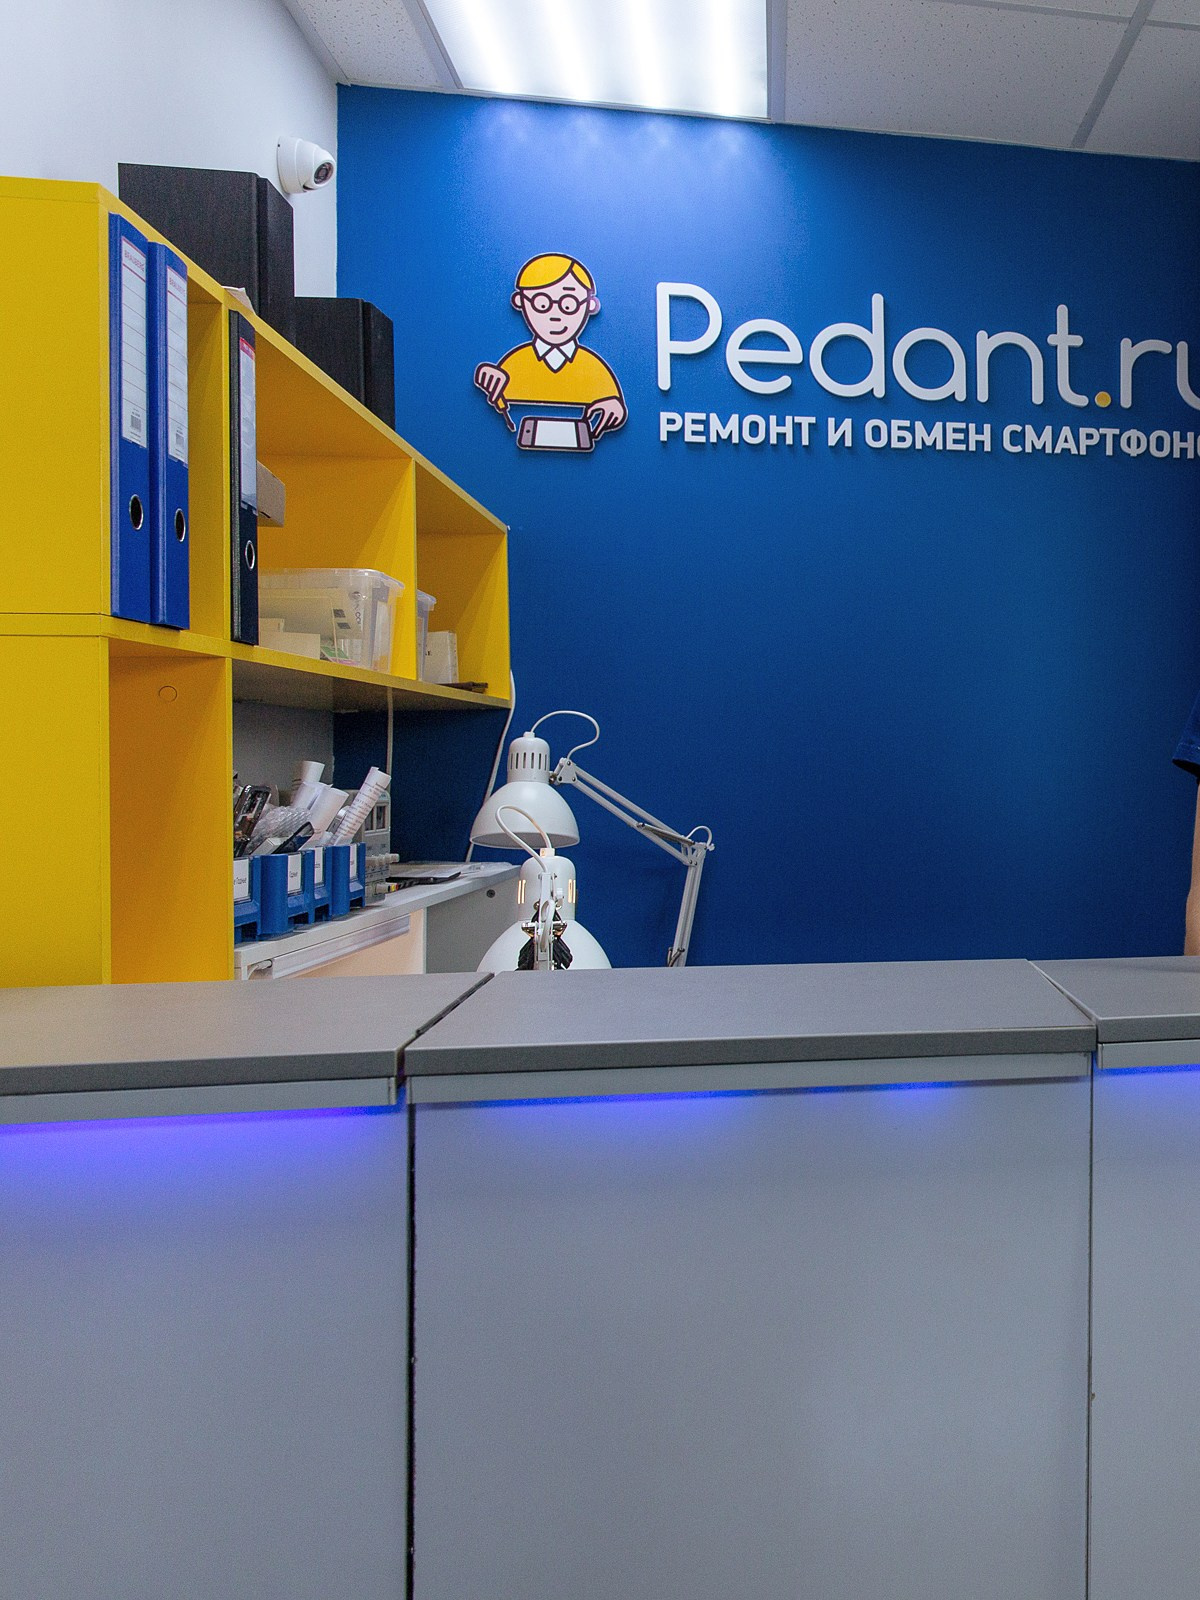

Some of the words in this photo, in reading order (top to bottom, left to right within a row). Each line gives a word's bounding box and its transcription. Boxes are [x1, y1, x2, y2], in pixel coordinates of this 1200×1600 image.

[659, 411, 816, 446] РЕМОНТ
[827, 417, 852, 447] И
[864, 418, 991, 452] ОБМЕН
